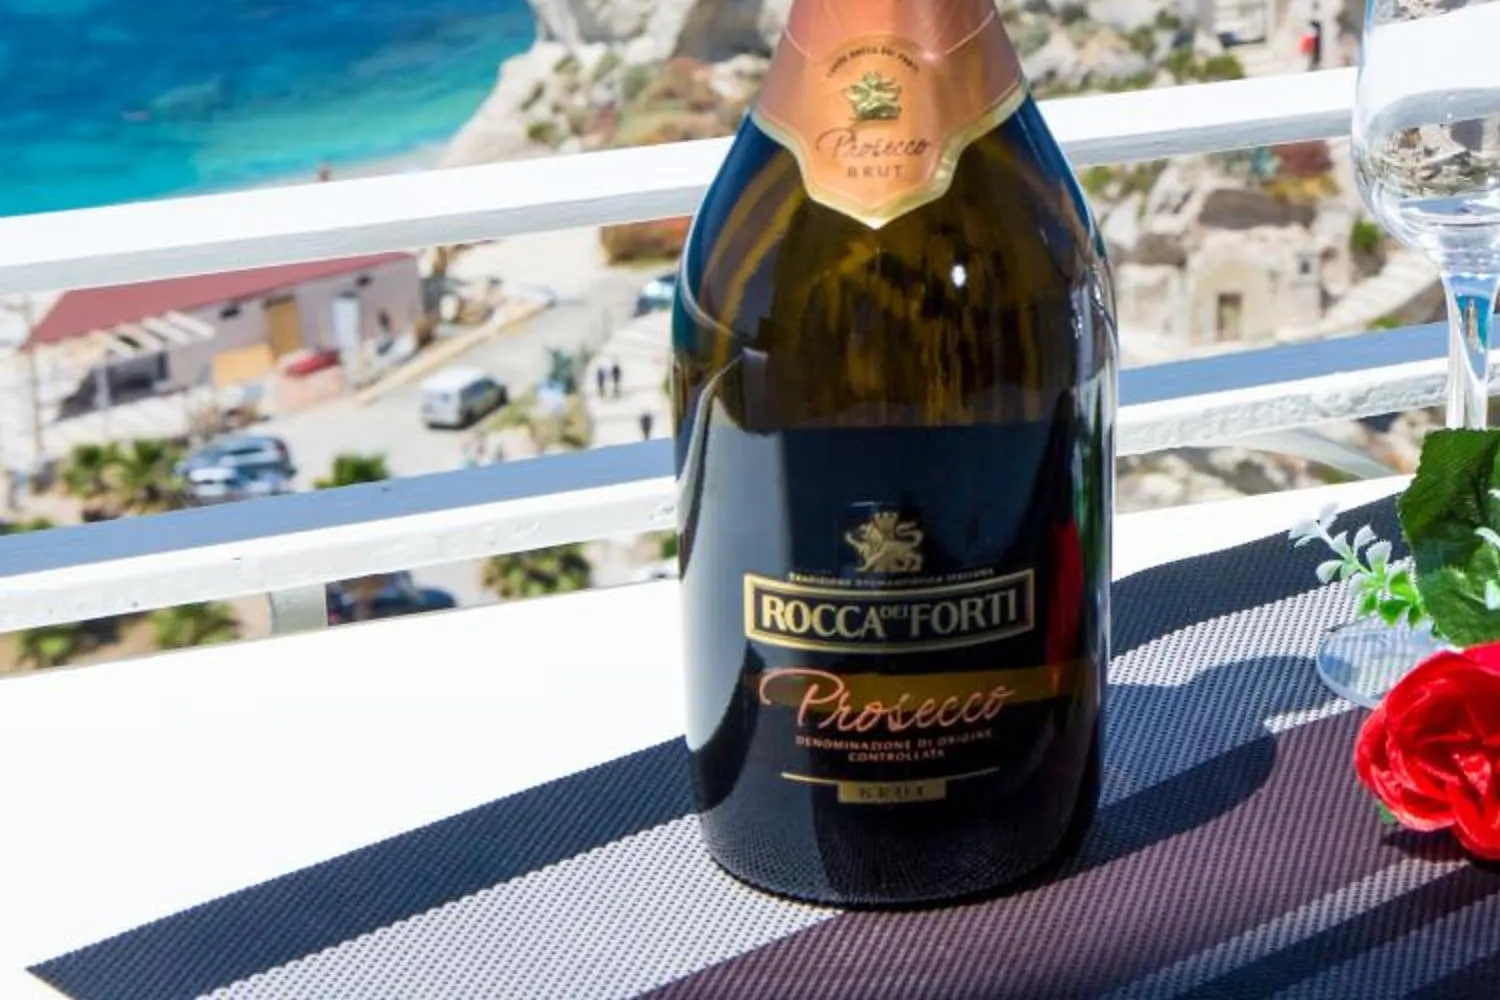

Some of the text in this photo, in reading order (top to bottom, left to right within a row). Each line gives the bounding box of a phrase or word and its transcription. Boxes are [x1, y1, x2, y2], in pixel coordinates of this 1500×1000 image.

[847, 164, 904, 179] BRUT
[761, 594, 885, 640] ROCCA
[910, 588, 1018, 638] FORTI
[759, 667, 1017, 733] Prosecco
[795, 734, 912, 751] DENOMINAZIONE
[917, 737, 934, 748] DI
[848, 749, 945, 763] CONTROLLATA
